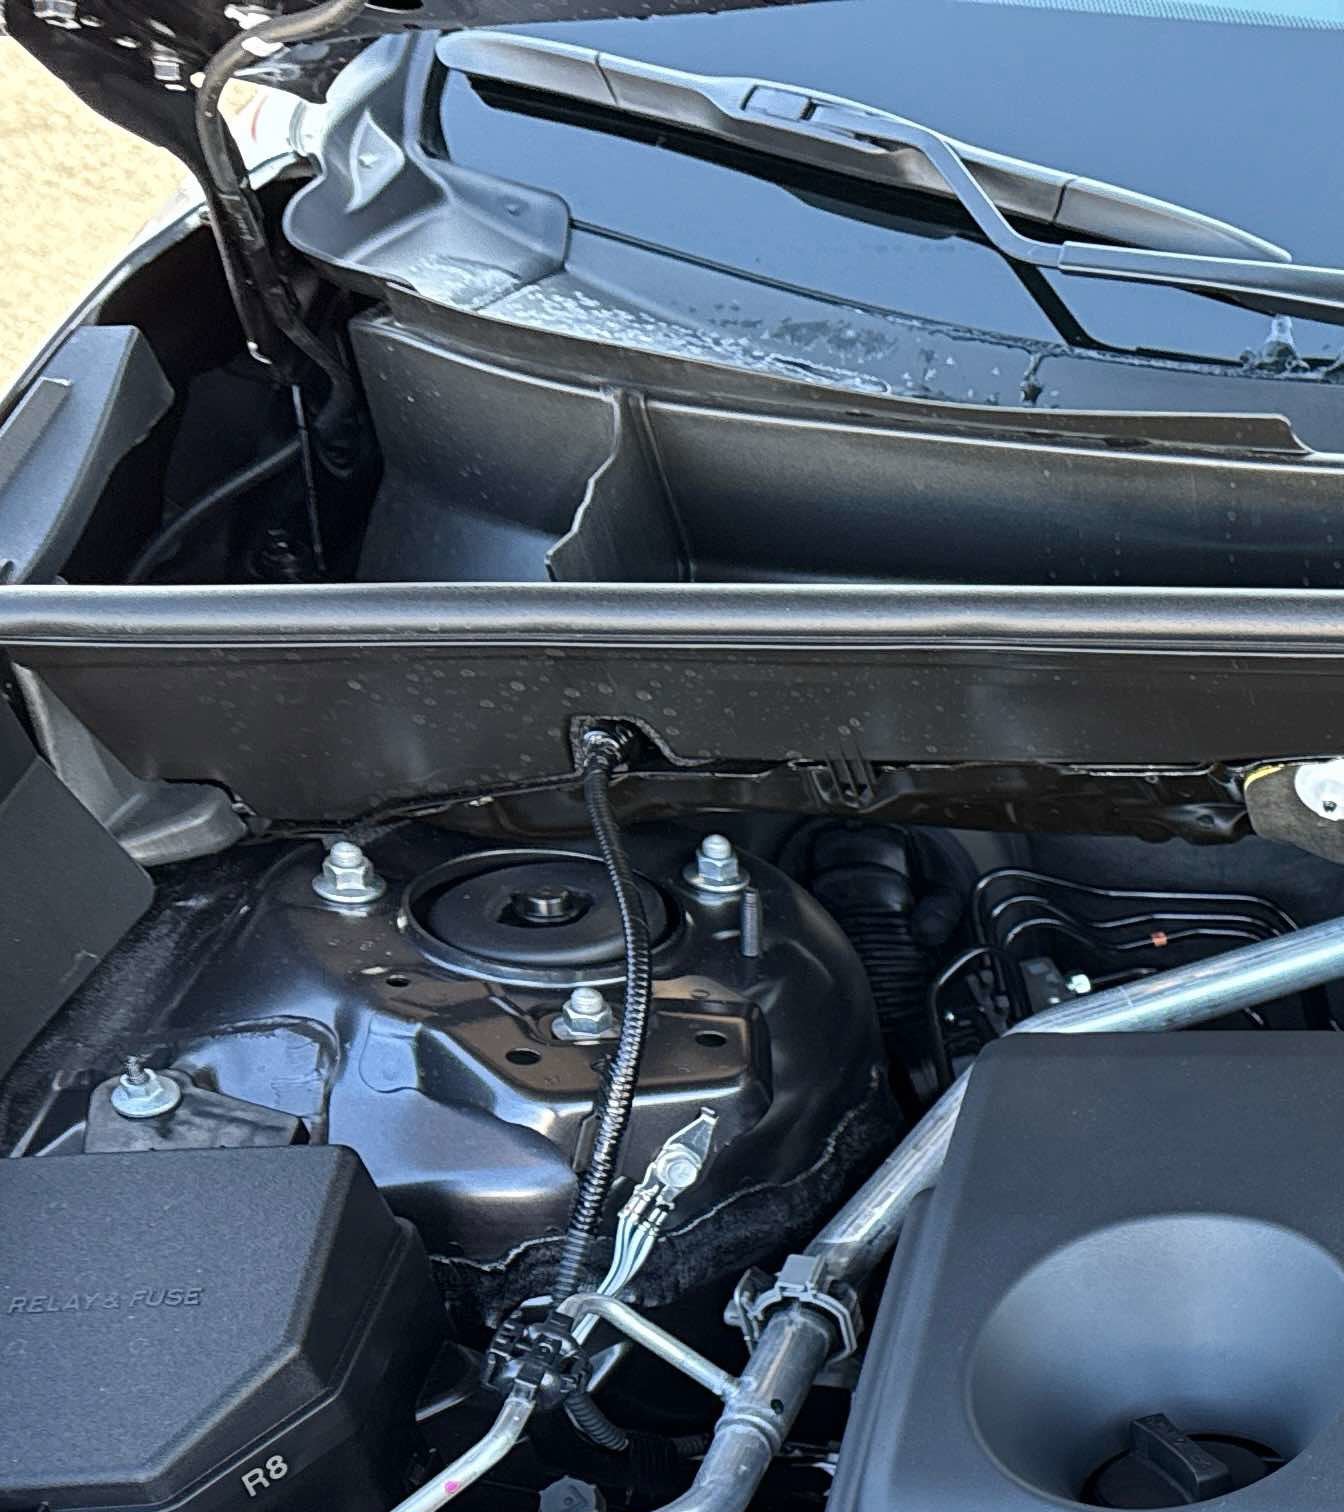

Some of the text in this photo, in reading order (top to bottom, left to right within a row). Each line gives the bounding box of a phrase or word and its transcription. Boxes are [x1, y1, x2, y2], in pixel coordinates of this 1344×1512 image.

[8, 1287, 205, 1315] RELAY & FUSE
[241, 1455, 289, 1497] R8
